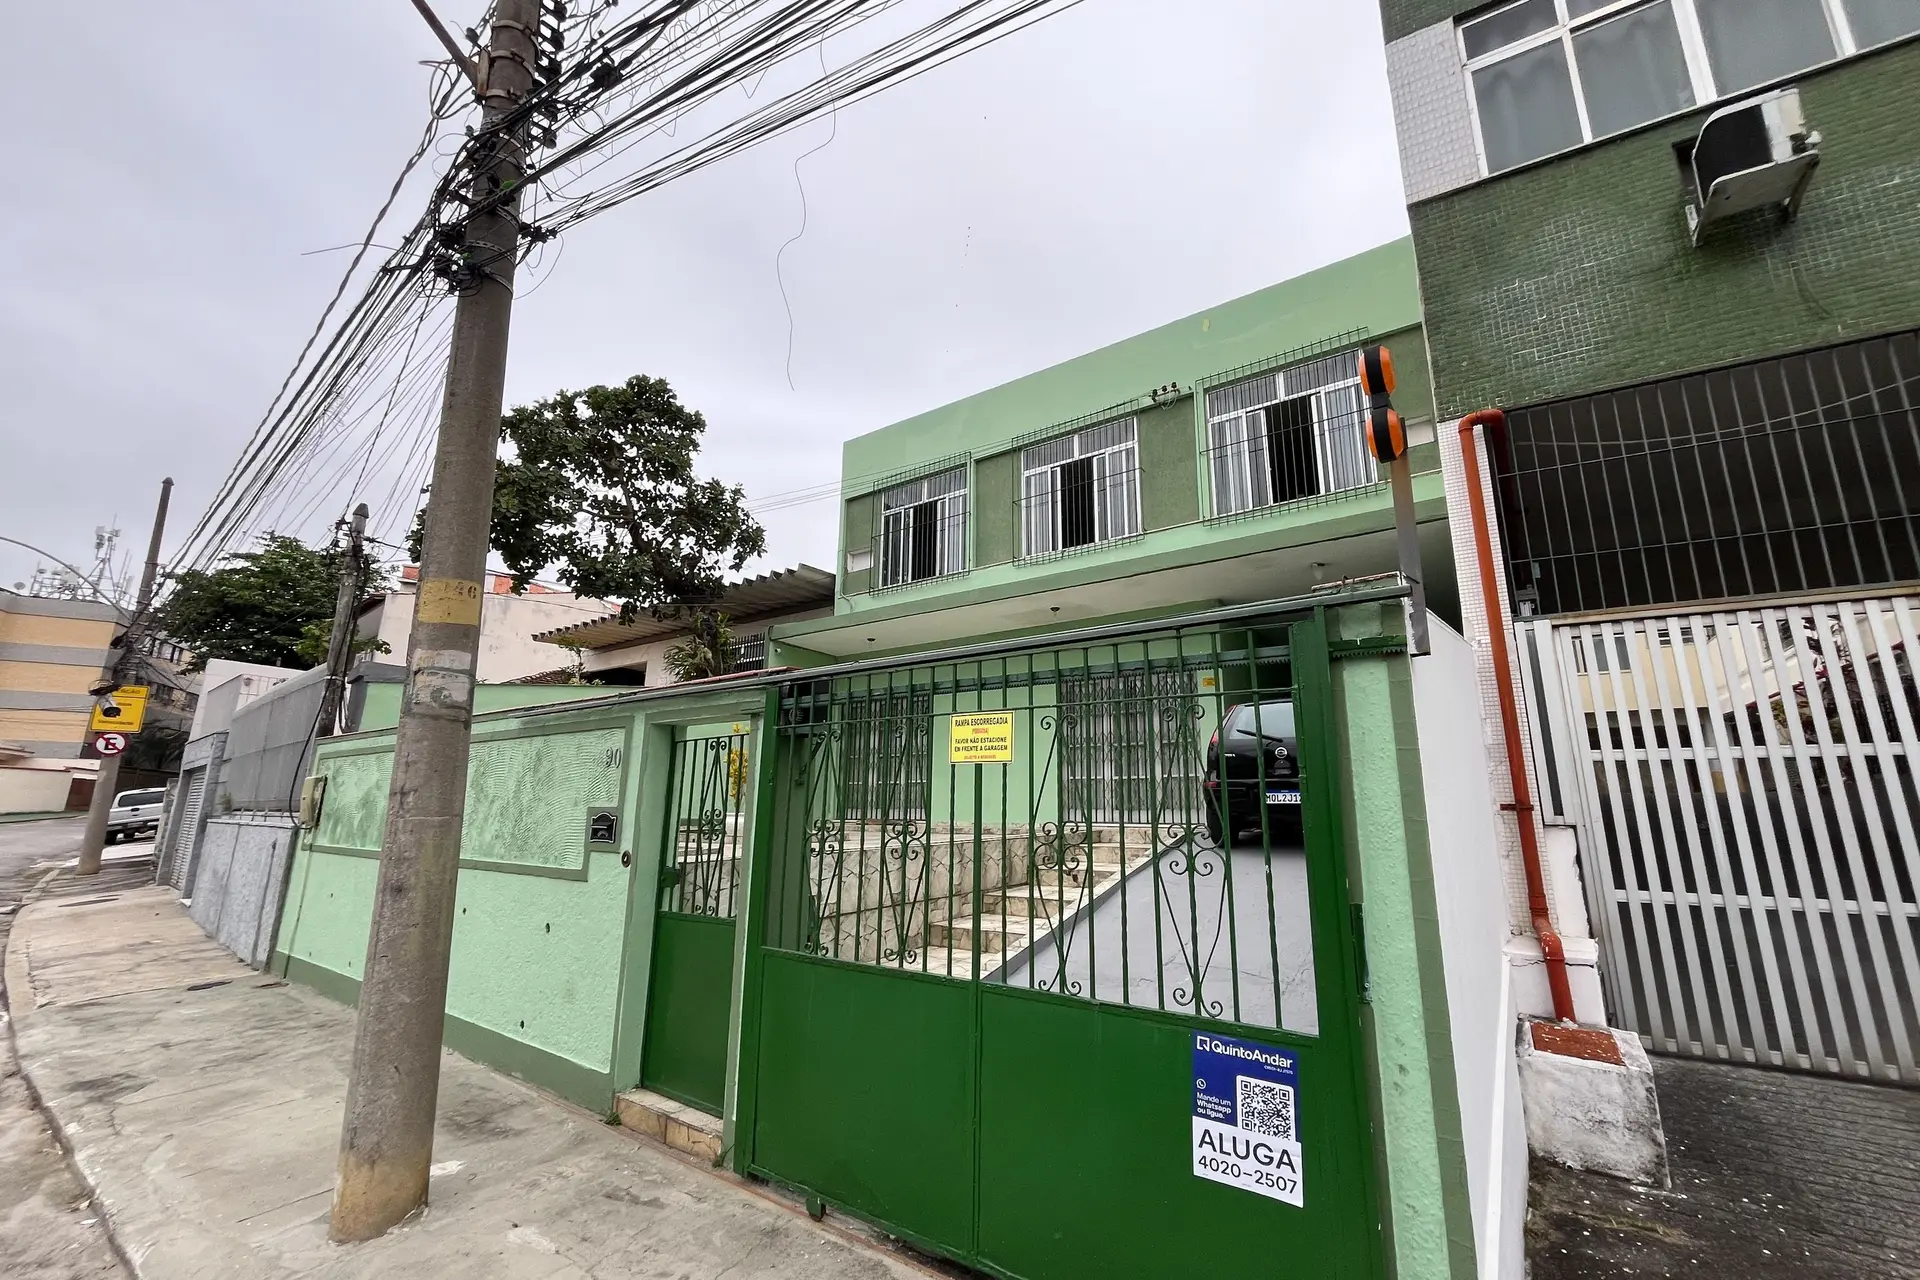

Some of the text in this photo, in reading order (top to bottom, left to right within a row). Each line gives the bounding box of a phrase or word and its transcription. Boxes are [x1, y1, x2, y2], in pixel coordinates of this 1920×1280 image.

[955, 717, 1008, 727] RAMPA ESCORREGADIA
[104, 737, 118, 751] E
[970, 736, 979, 744] NÃO
[980, 736, 1007, 744] ESTACIONE
[954, 745, 961, 753] EM
[605, 746, 622, 768] 90
[1212, 1040, 1293, 1069] QuintoAndar
[1197, 1092, 1219, 1104] Mande
[1197, 1099, 1232, 1114] Whatsapp
[1206, 1108, 1225, 1119] ligue.
[1198, 1128, 1297, 1174] ALUGA
[1198, 1155, 1297, 1194] 4020-2507
